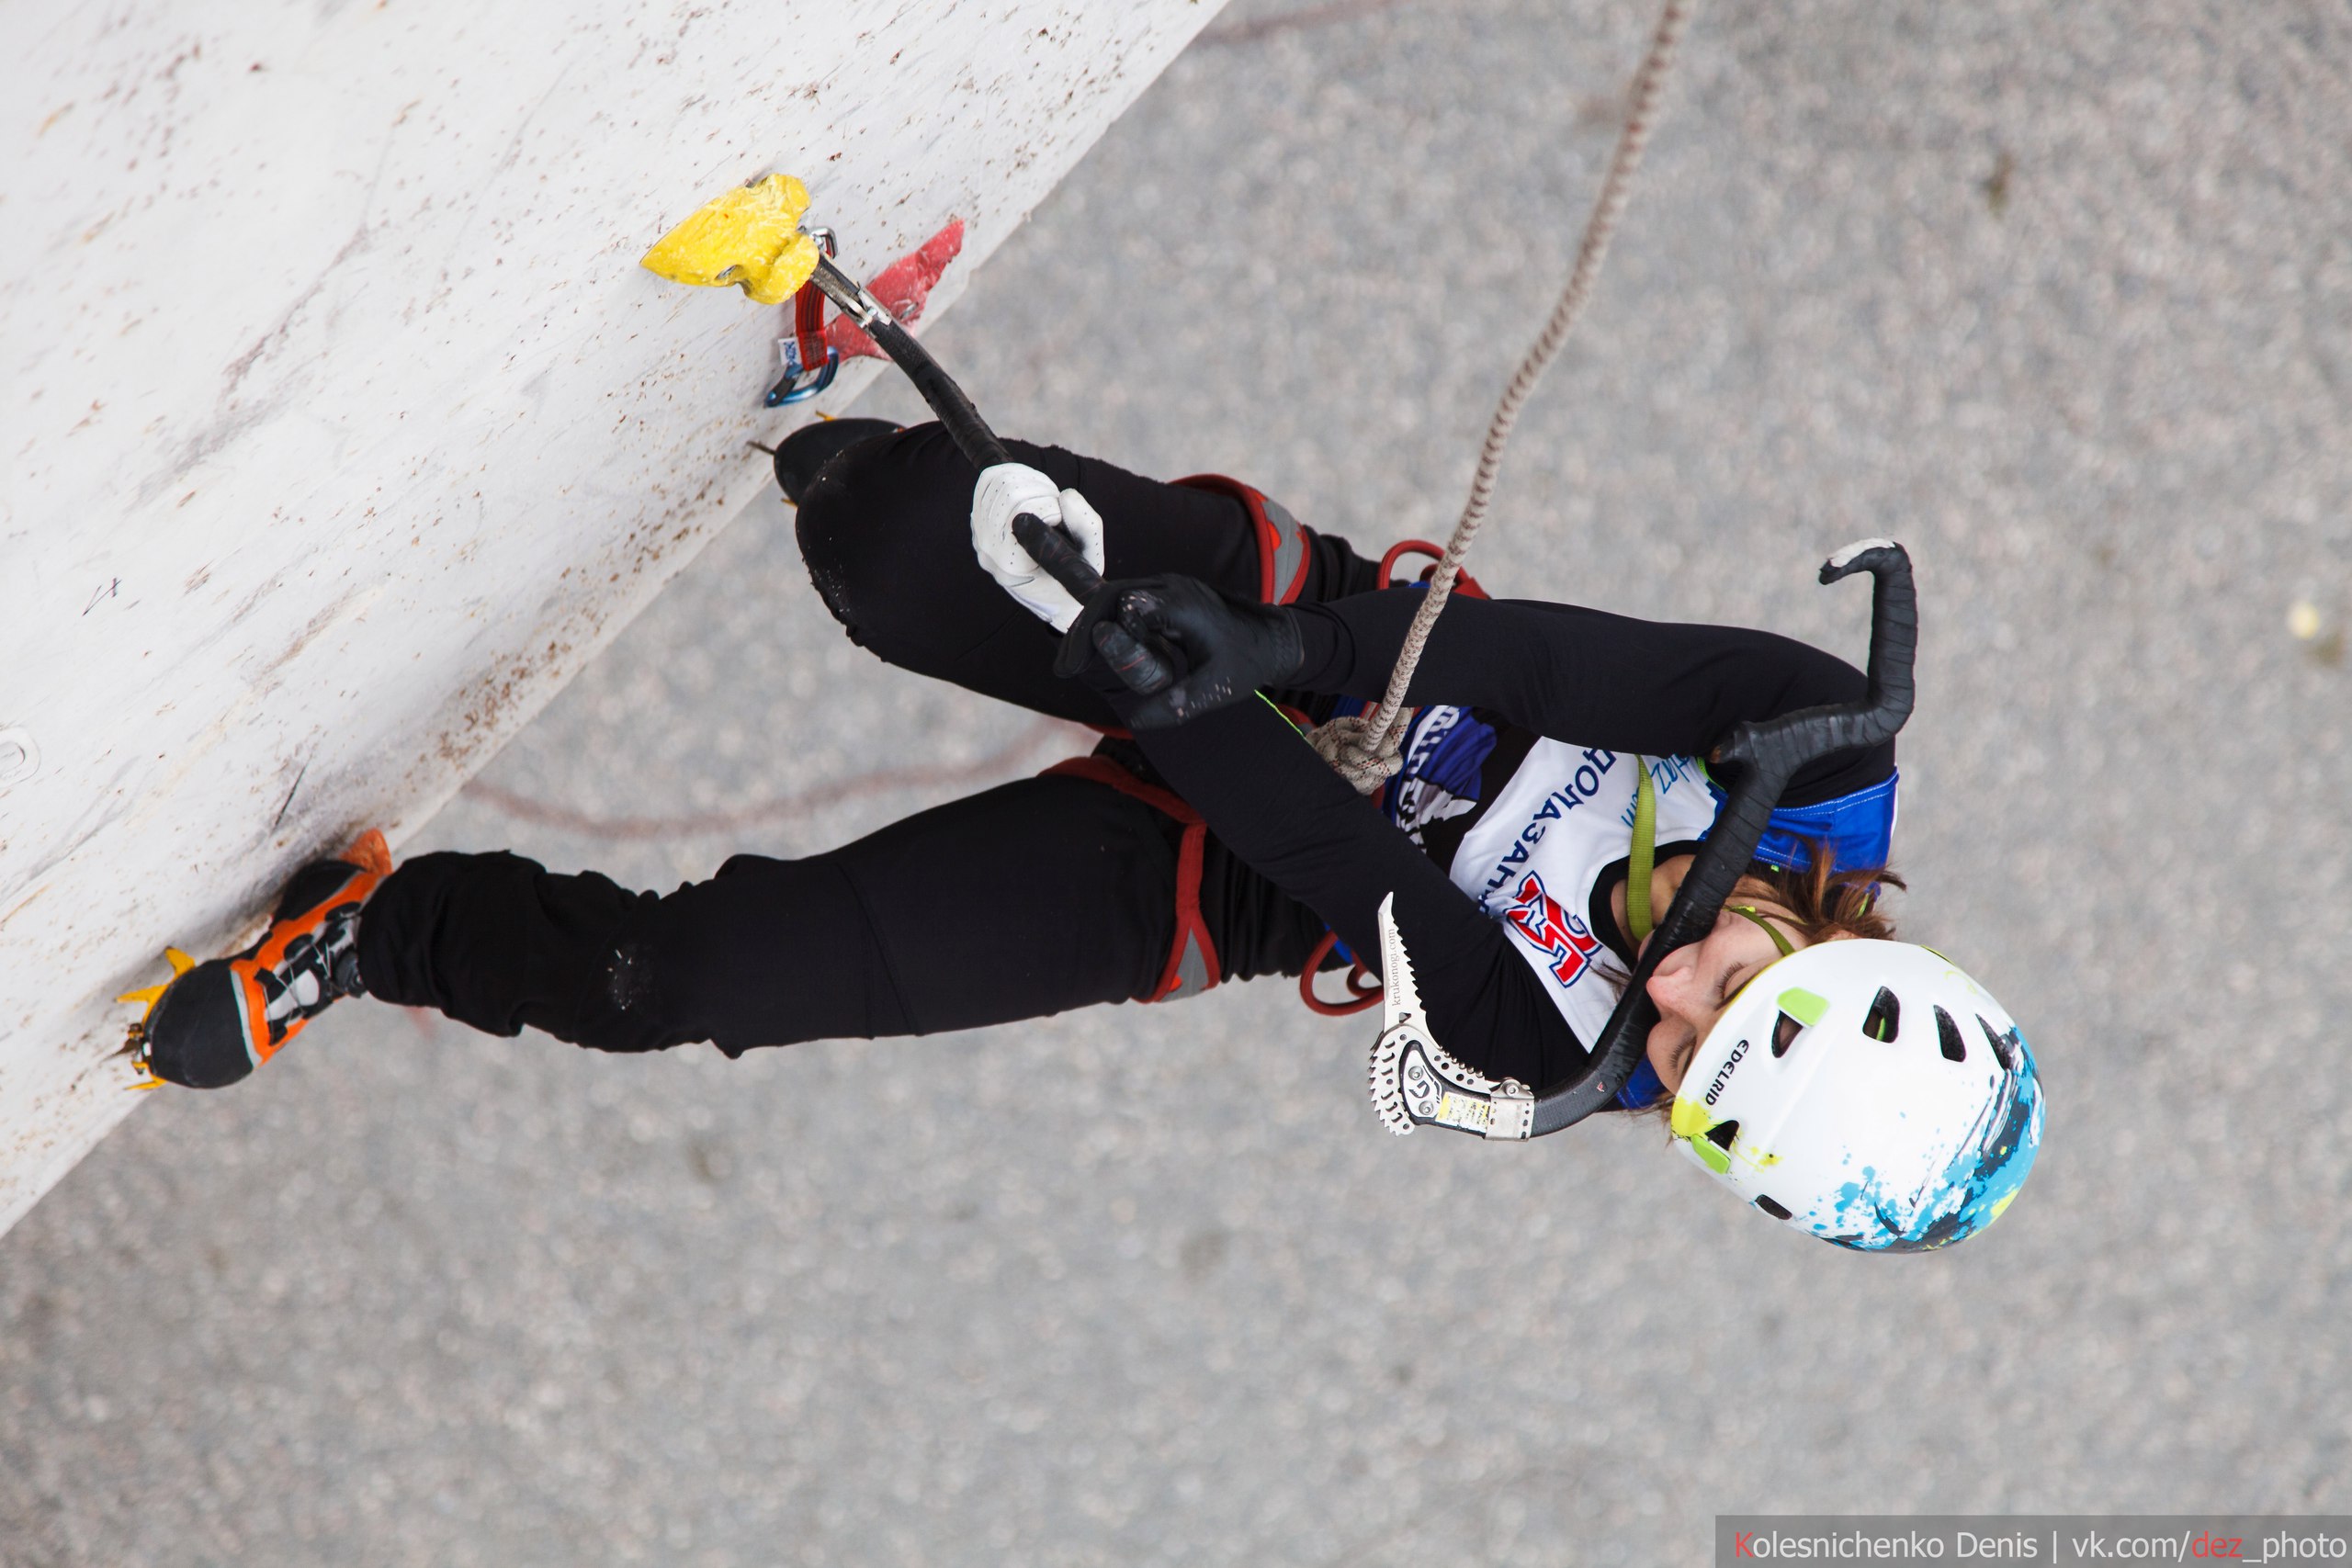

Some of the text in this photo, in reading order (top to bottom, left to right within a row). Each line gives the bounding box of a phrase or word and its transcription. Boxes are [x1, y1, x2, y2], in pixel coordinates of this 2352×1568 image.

[1478, 748, 1617, 915] ДОЛАЗАН
[1388, 928, 1401, 1007] krukonogi.com
[1503, 869, 1604, 988] 25
[1705, 1039, 1750, 1106] EDELRID
